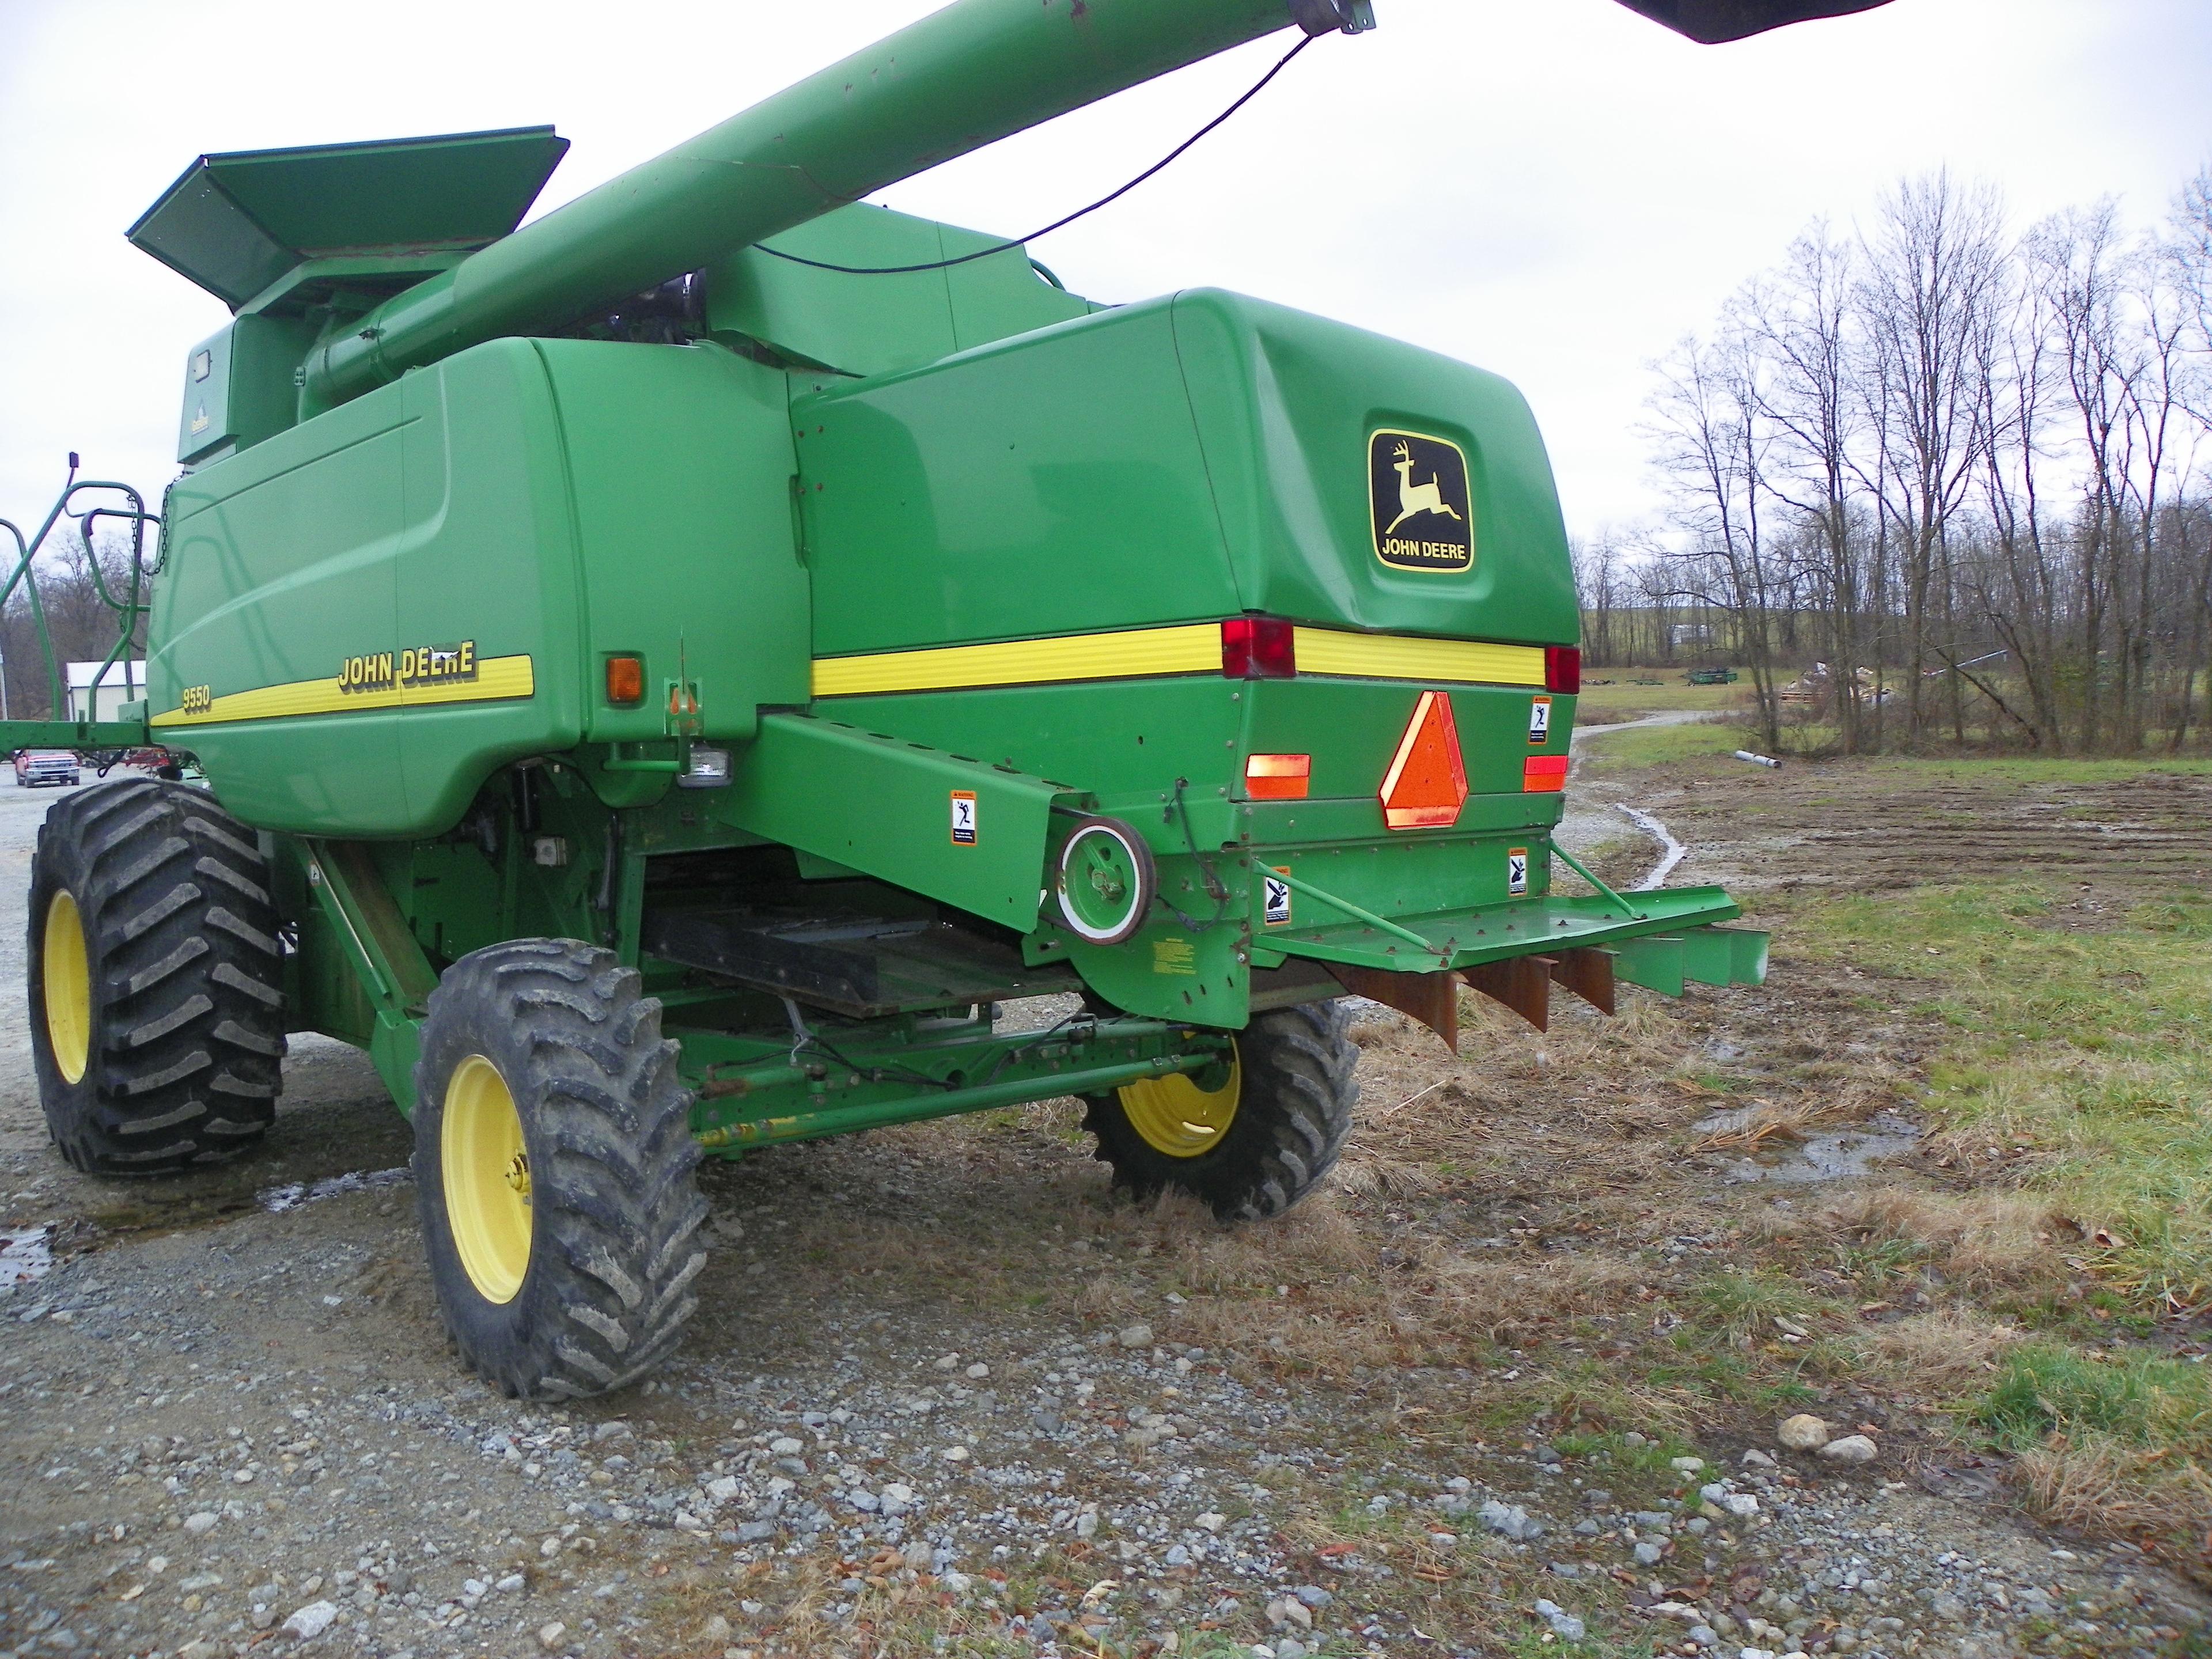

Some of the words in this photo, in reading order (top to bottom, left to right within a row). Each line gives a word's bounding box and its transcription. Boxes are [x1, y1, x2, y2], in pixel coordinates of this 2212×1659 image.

[1382, 538, 1419, 556] JOHN
[1422, 541, 1466, 560] DEERE
[338, 652, 395, 690] JOHN
[184, 684, 210, 710] 9550
